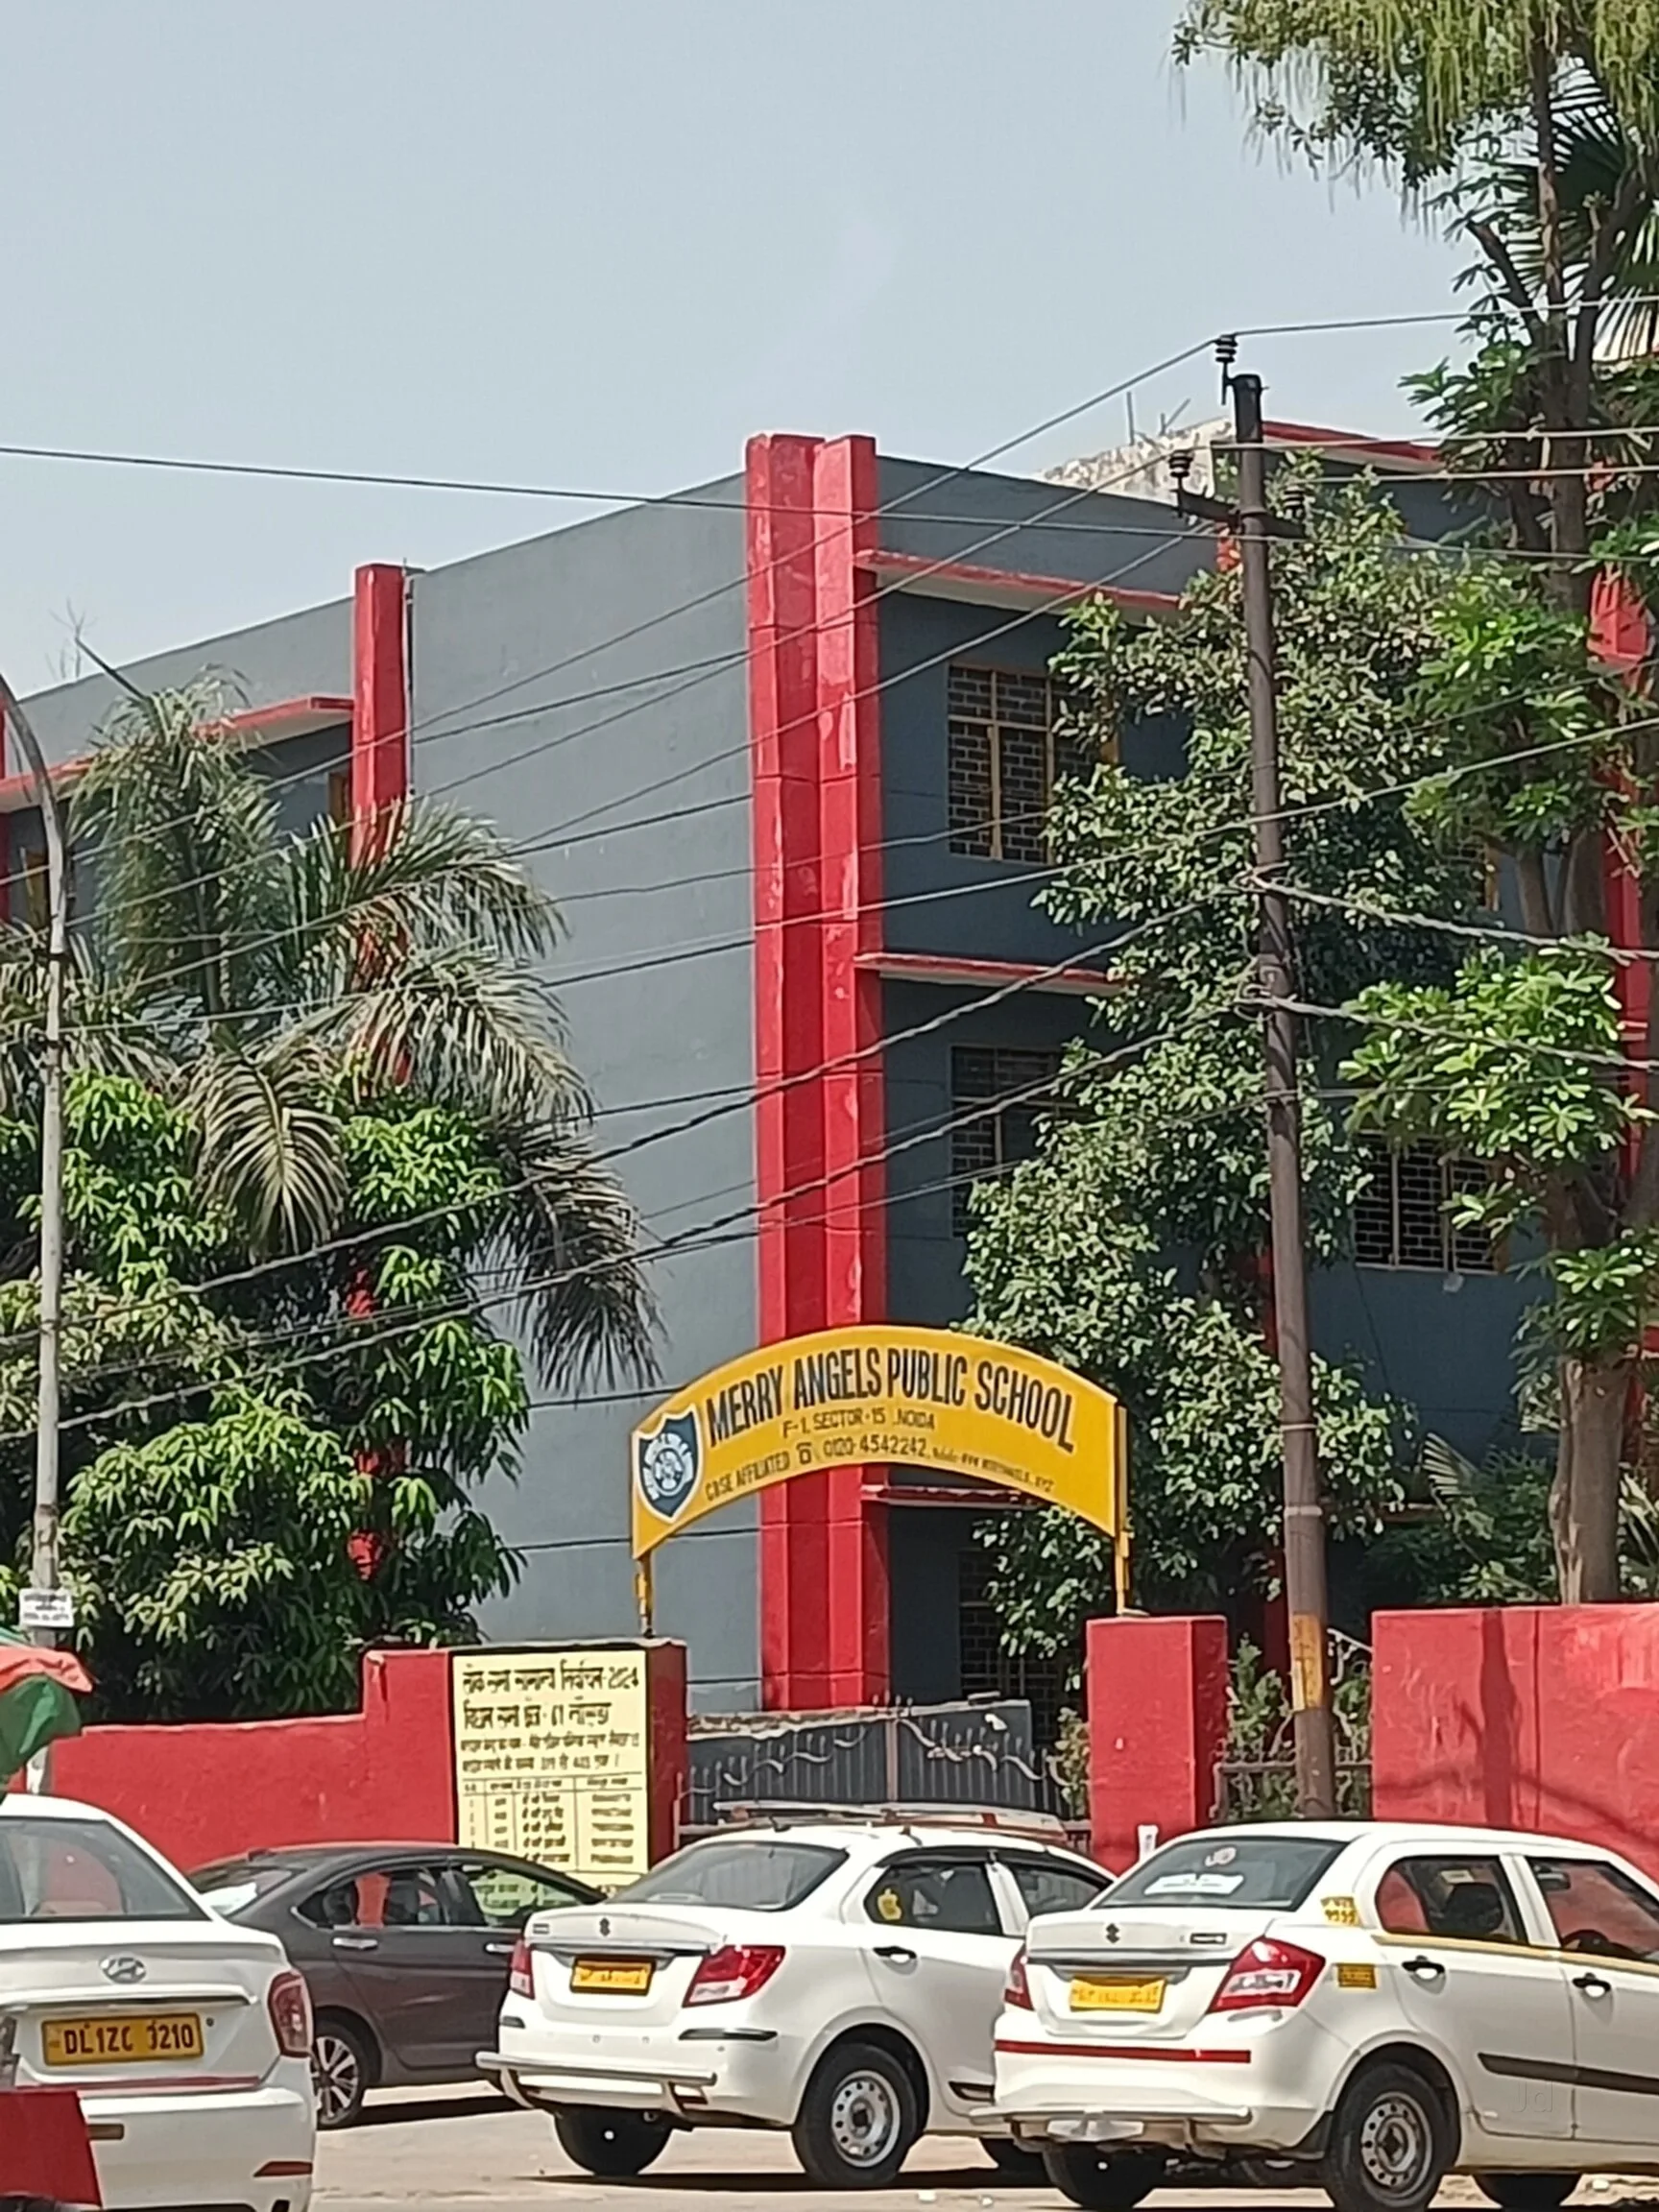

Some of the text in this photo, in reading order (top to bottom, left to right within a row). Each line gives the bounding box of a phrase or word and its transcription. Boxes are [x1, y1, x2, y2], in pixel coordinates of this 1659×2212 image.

[706, 1347, 1074, 1454] MERRY ANGELS PUBLIC SCHOOL
